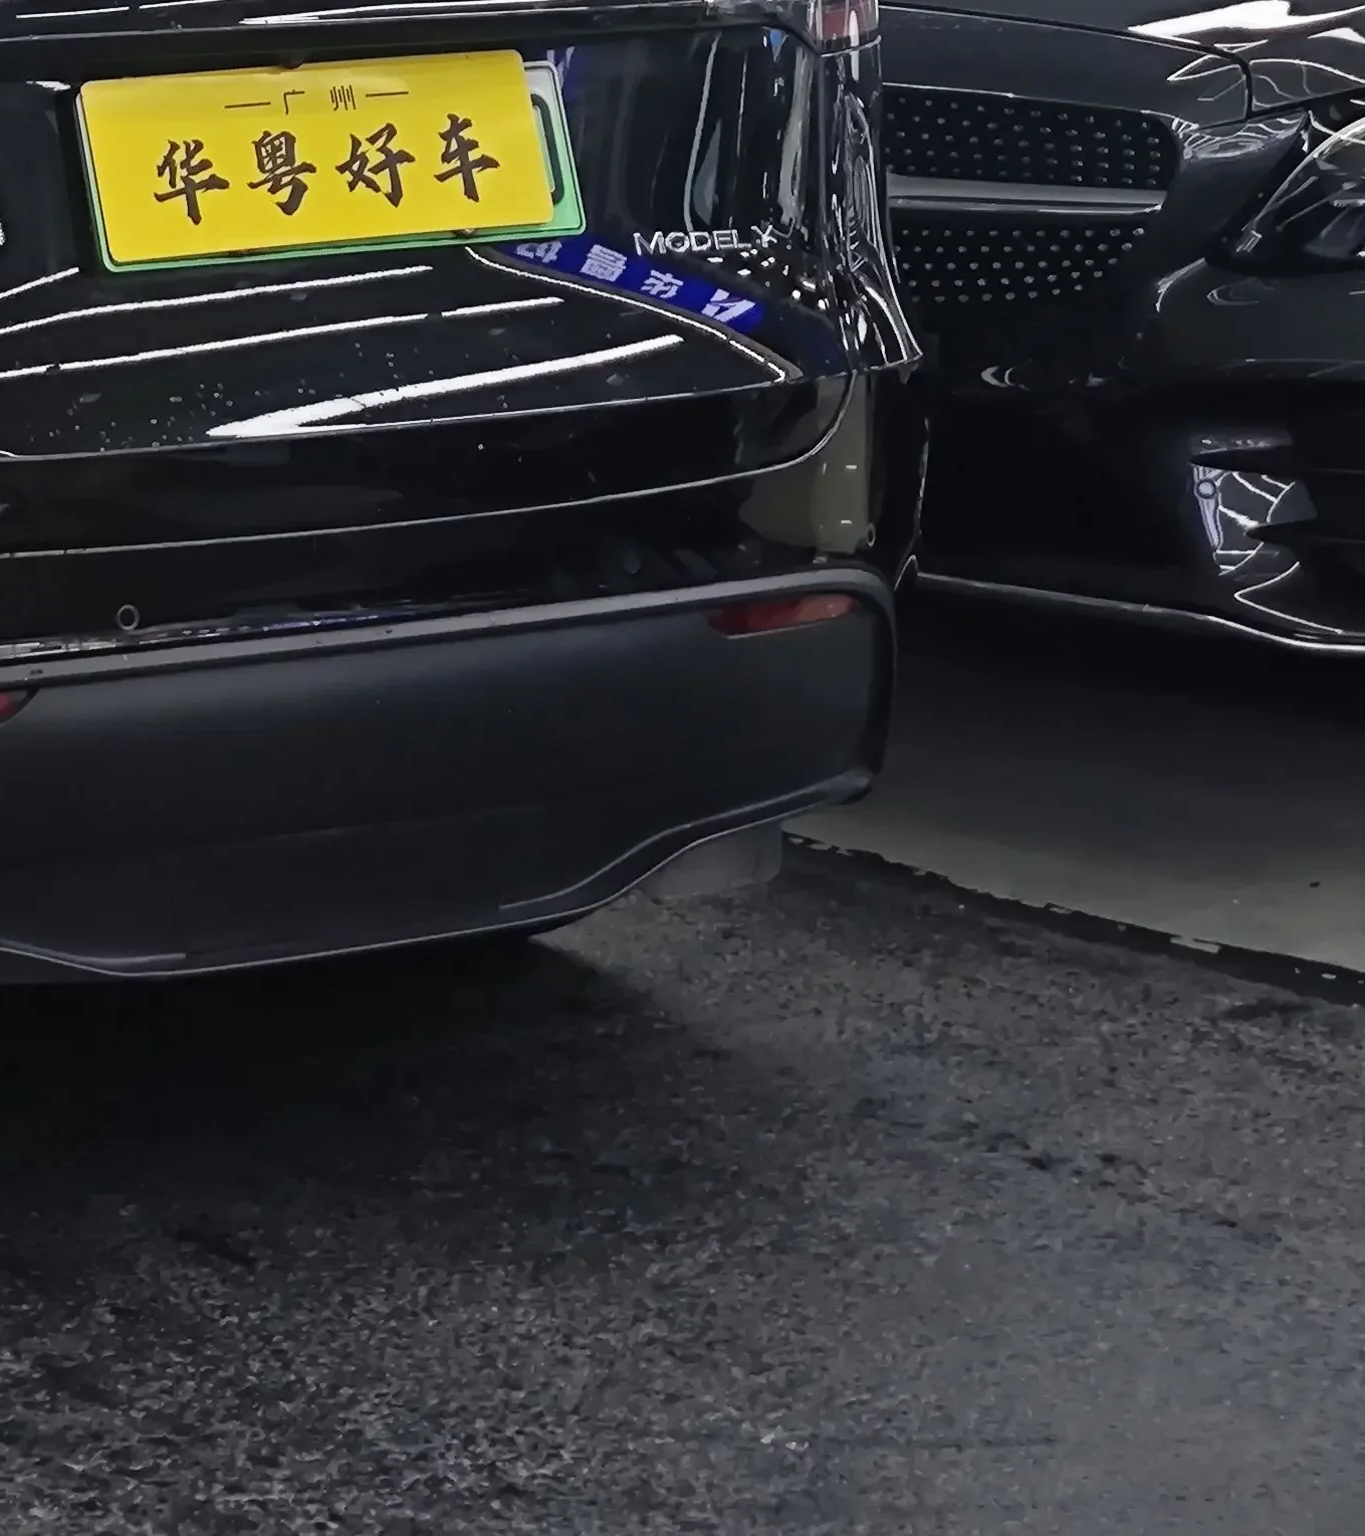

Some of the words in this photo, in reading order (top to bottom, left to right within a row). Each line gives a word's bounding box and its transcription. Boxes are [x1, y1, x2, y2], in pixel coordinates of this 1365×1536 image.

[283, 84, 358, 115] 广州
[153, 113, 501, 226] 华粤好车
[633, 229, 751, 257] MODEL
[750, 224, 777, 248] Y
